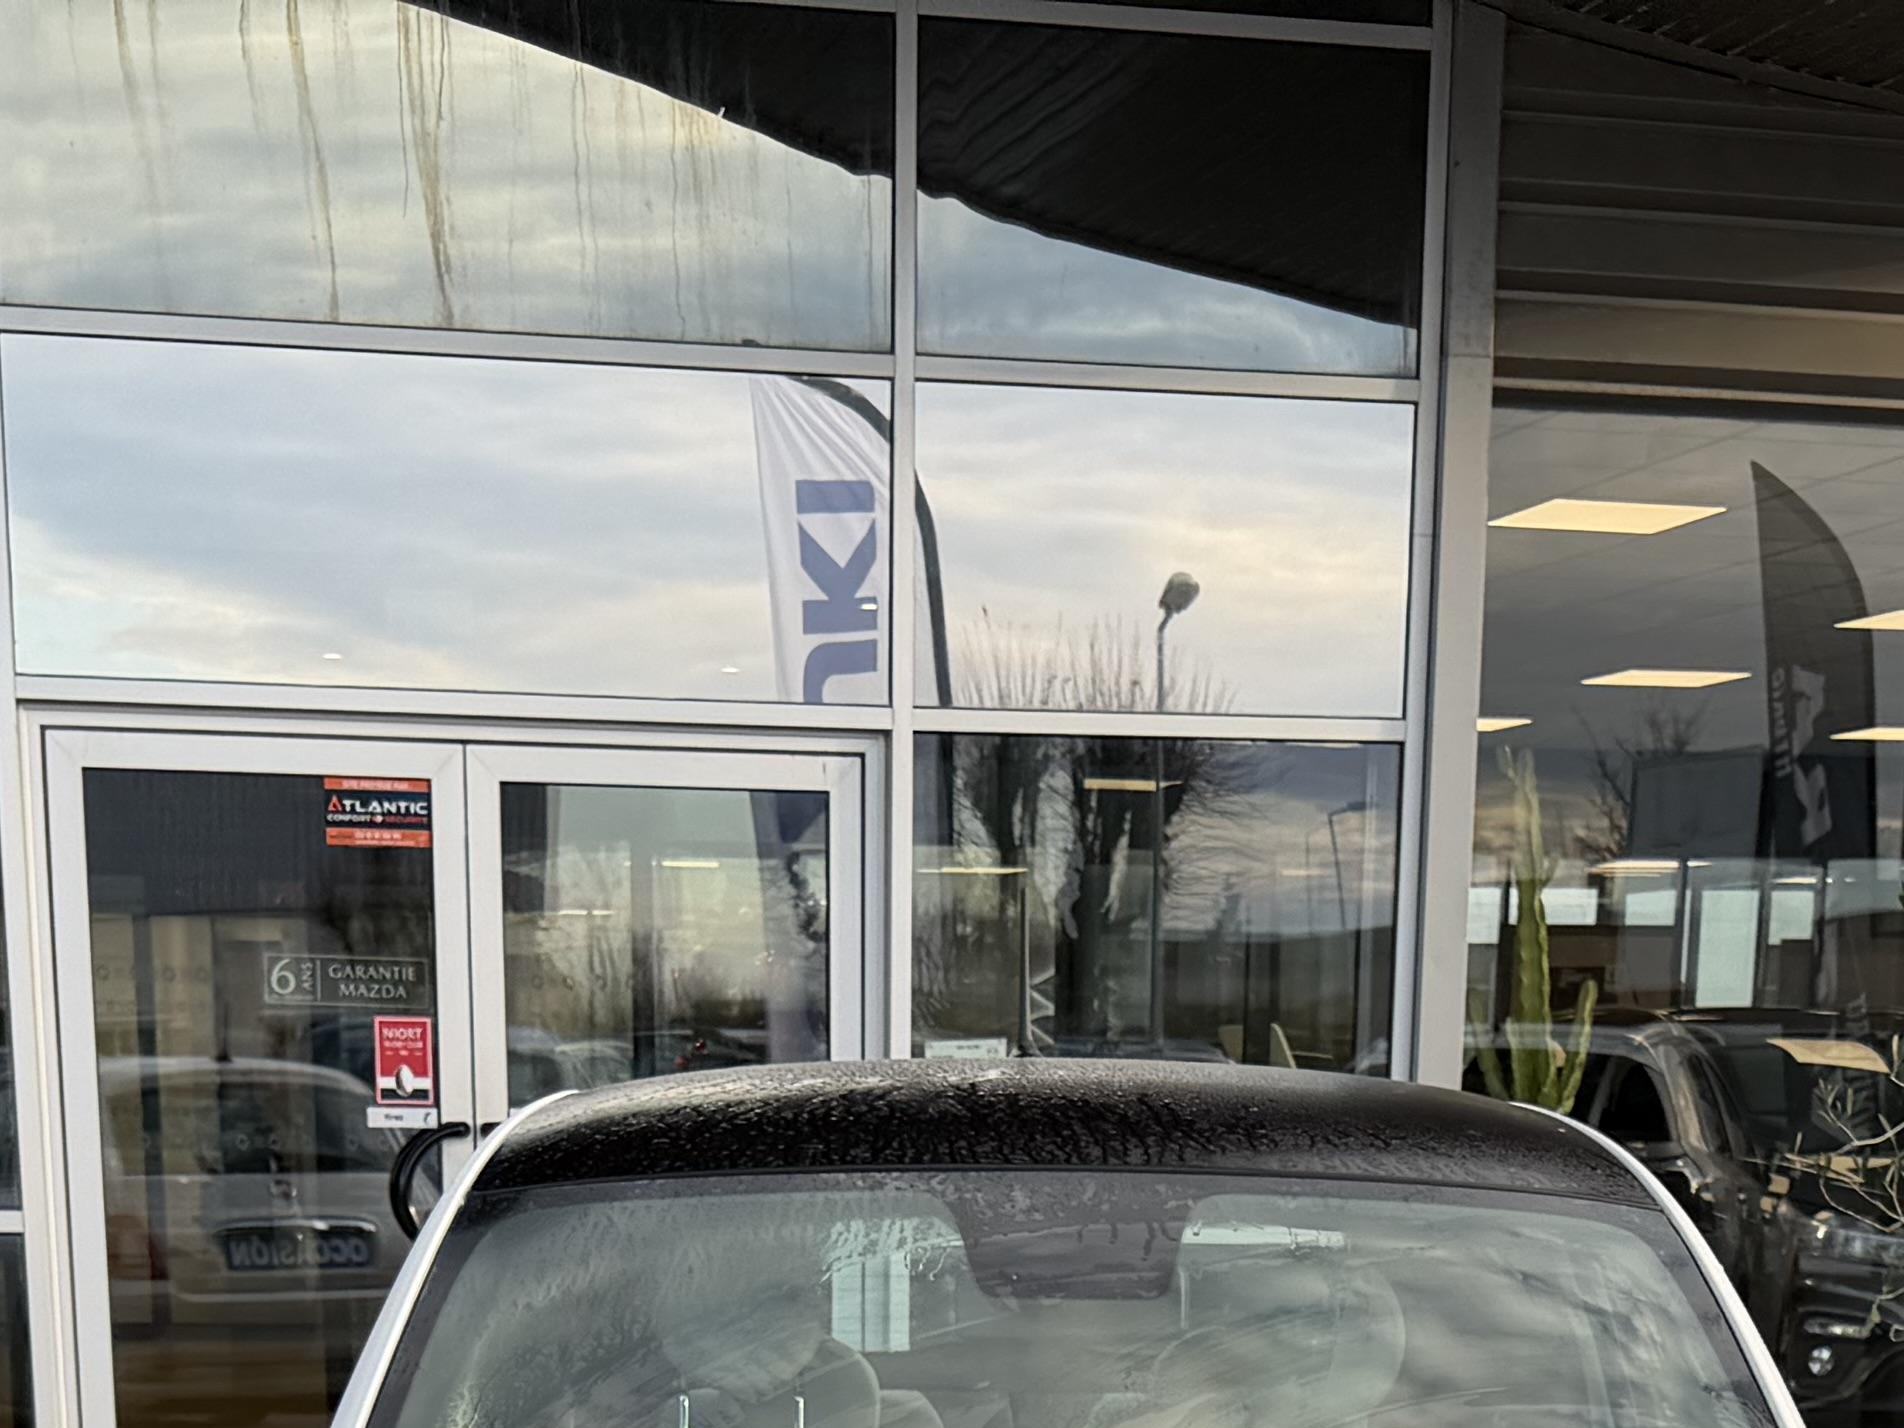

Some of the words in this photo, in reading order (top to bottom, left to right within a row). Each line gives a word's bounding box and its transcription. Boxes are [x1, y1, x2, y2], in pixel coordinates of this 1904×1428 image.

[327, 795, 428, 815] ATLANTIC
[270, 958, 296, 995] 6
[301, 962, 314, 991] ANS
[328, 963, 417, 981] GARANTIE
[339, 984, 408, 999] MAZDA
